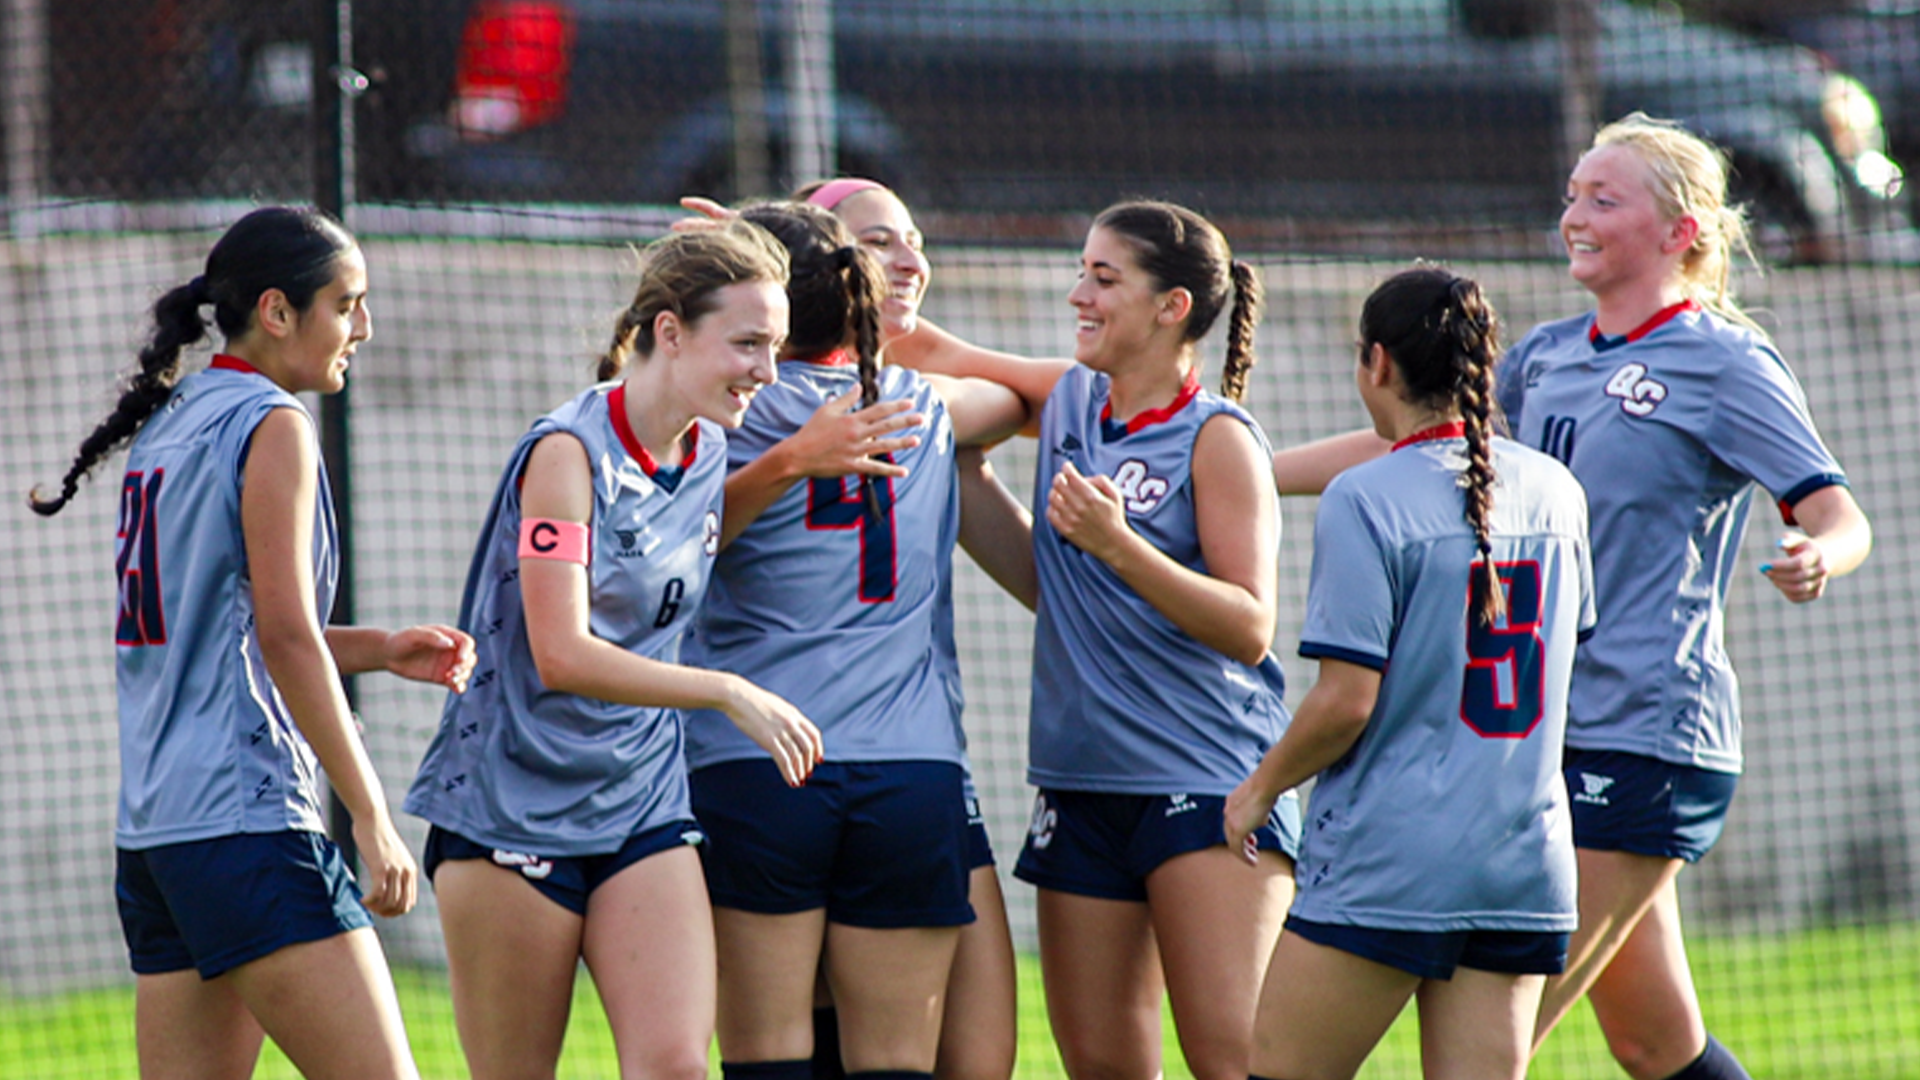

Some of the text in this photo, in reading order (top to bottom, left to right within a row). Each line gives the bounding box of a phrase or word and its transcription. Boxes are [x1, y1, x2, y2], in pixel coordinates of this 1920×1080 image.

[1604, 361, 1669, 418] QC
[1540, 415, 1577, 467] 10
[531, 522, 560, 552] C
[805, 450, 898, 603] 4
[115, 467, 167, 646] 21
[653, 577, 685, 629] 6
[1459, 560, 1545, 739] 5
